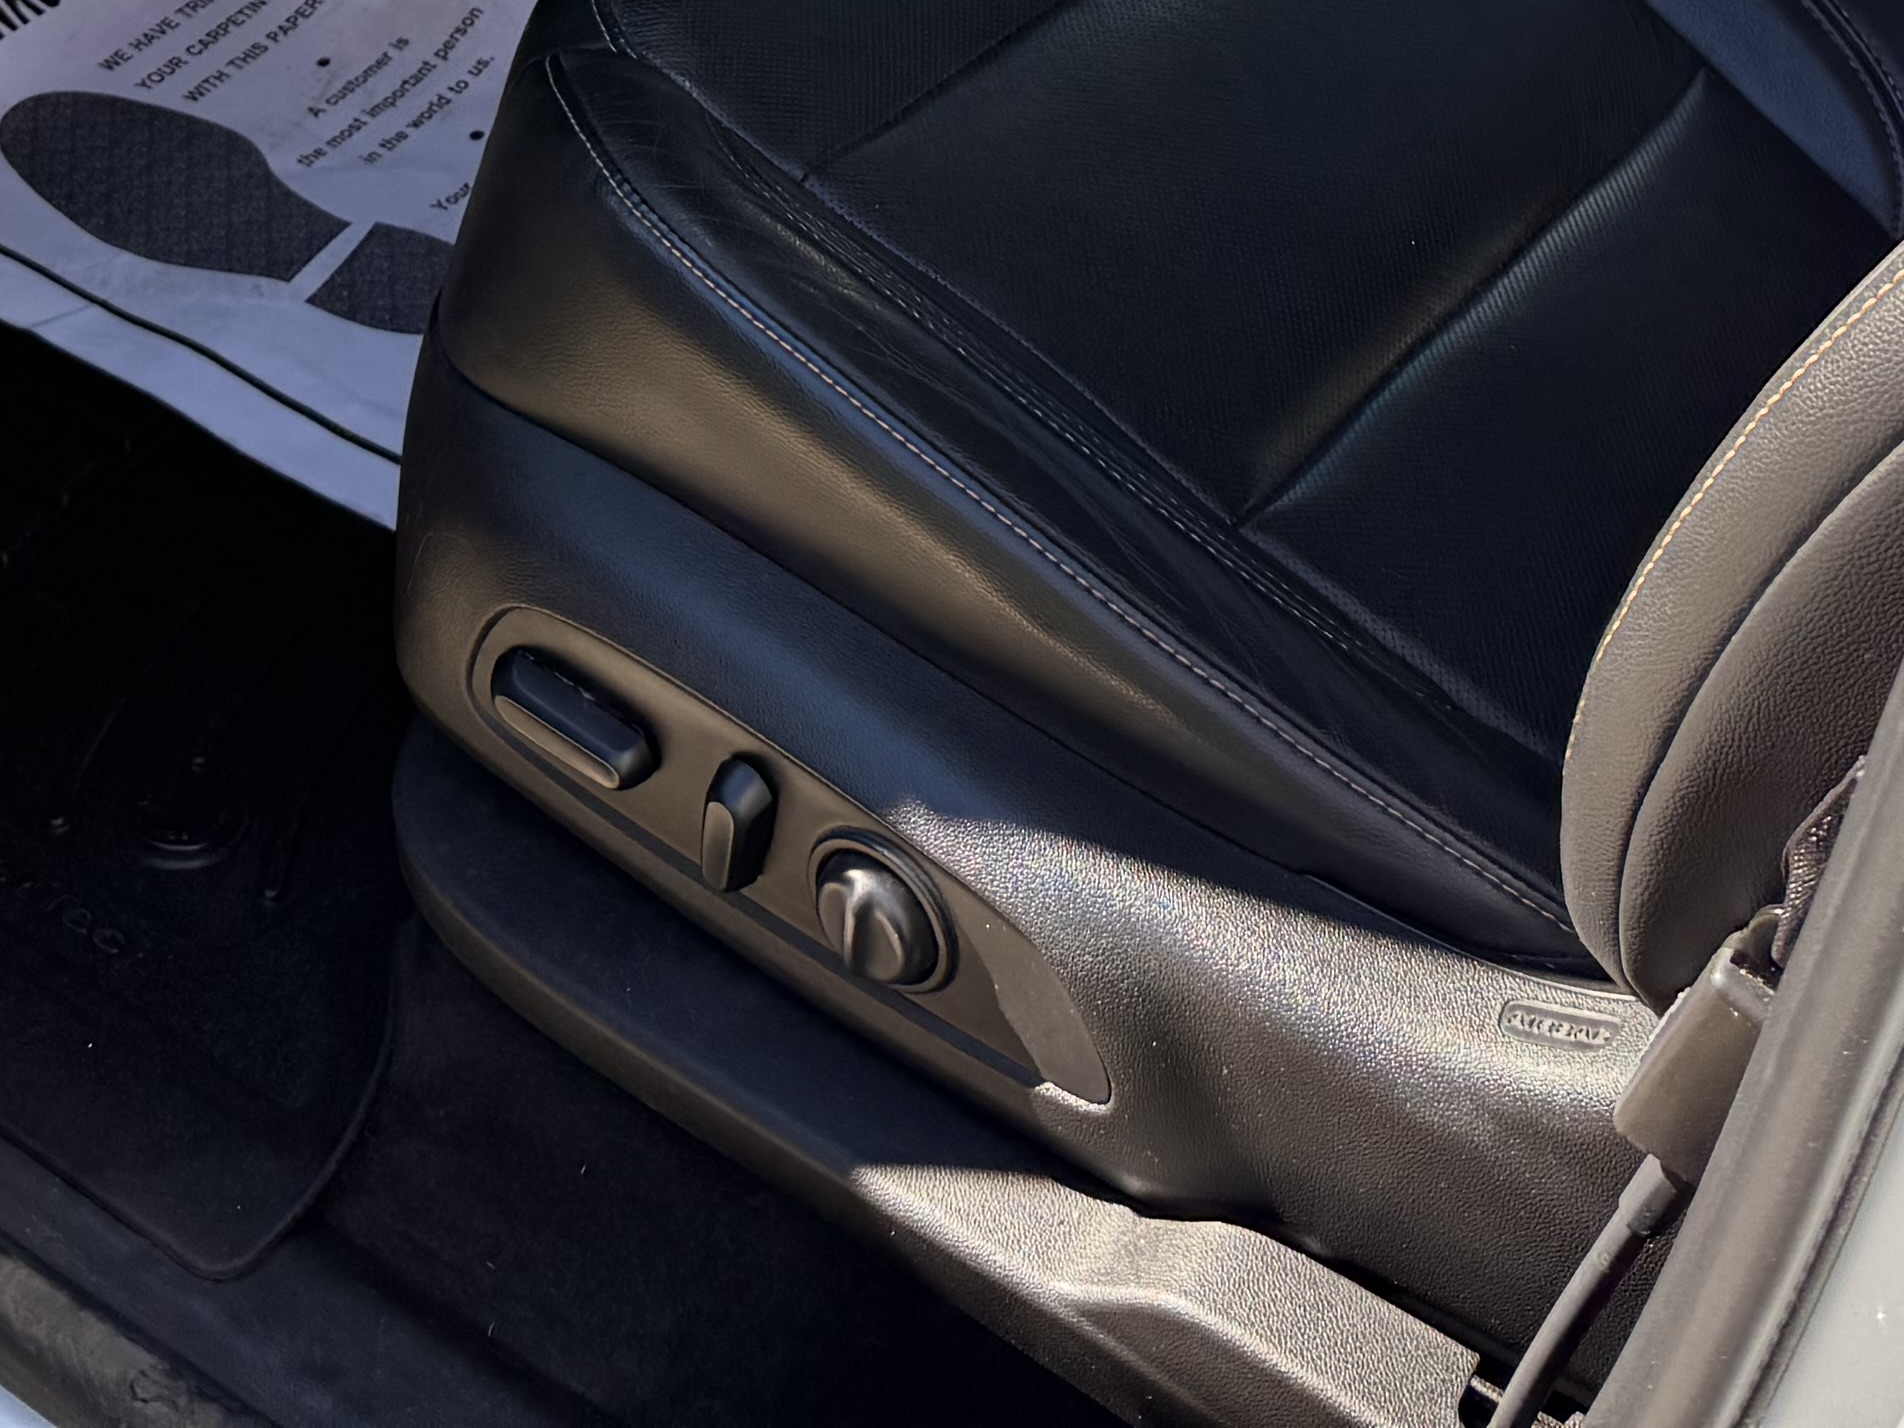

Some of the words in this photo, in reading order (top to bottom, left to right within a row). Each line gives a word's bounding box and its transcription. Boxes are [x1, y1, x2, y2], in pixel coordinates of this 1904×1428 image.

[98, 48, 133, 72] WE
[129, 16, 180, 52] HAVE
[134, 56, 189, 91] YOUR
[182, 69, 231, 104] WITH
[225, 41, 269, 73] THIS
[307, 105, 326, 118] A
[325, 51, 393, 107] customer
[388, 36, 410, 51] is
[297, 146, 328, 168] the
[326, 116, 368, 149] most
[362, 59, 438, 119] important
[434, 6, 484, 61] person
[359, 149, 382, 165] in
[379, 130, 409, 152] the
[405, 93, 452, 130] world
[448, 78, 469, 95] to
[467, 55, 495, 78] us.
